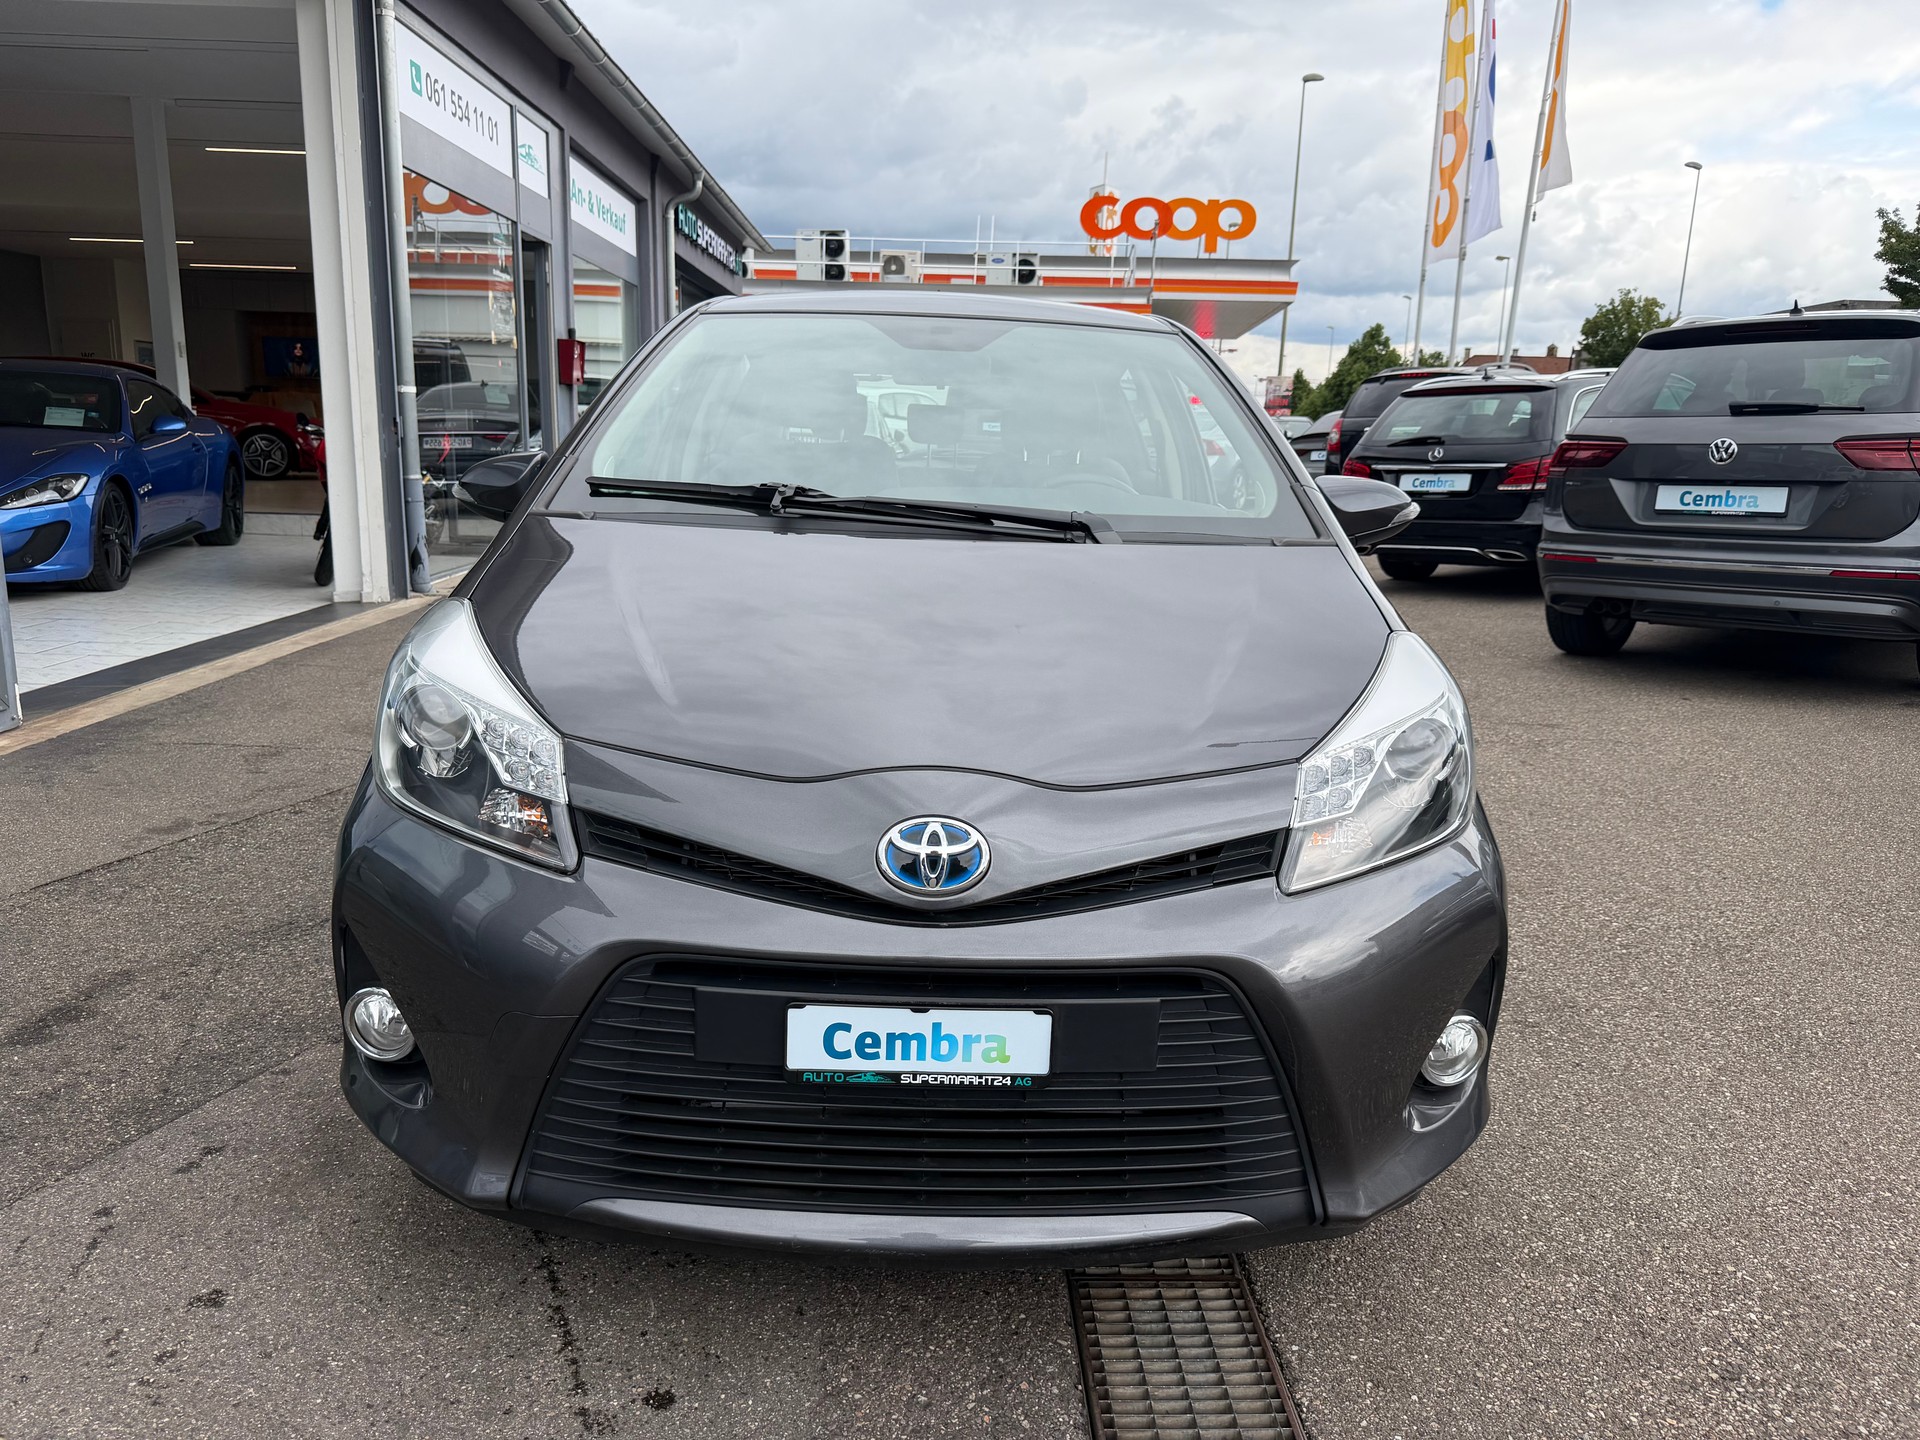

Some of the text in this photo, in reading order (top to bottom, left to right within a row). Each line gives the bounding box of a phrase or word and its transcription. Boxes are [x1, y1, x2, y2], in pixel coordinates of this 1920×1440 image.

[425, 72, 500, 146] 061 554 11 01
[570, 177, 627, 236] An- & Verkauf
[1080, 195, 1257, 254] coop
[1411, 477, 1455, 489] Cembra
[1679, 490, 1760, 509] Cembra
[822, 1021, 1011, 1064] Cembra
[803, 1072, 1032, 1086] AUTO SUPERMARKT24 AG
